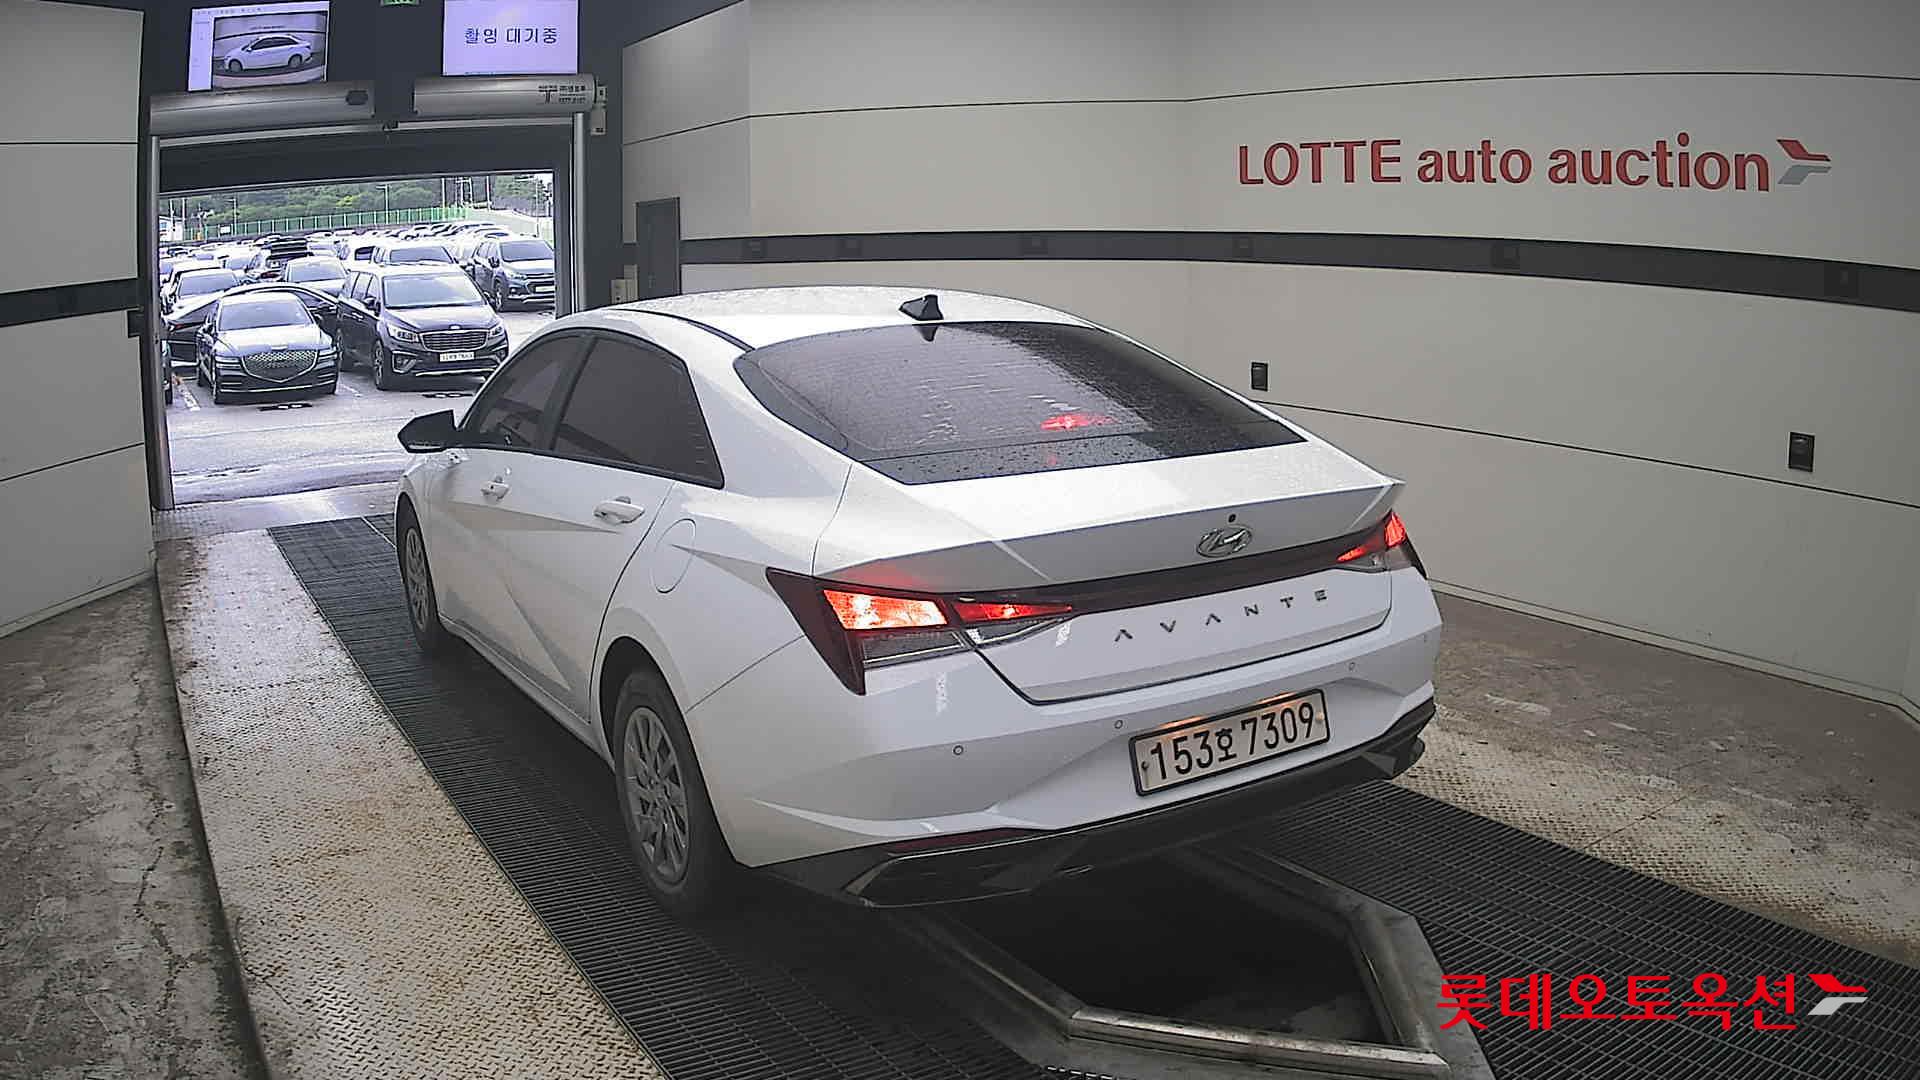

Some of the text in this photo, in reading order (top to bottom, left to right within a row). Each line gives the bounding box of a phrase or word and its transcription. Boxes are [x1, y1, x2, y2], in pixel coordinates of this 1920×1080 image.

[464, 27, 558, 45] 촬영 대기중
[1238, 131, 1771, 192] LOTTE auto auction
[1114, 588, 1329, 642] AVANTE
[1240, 701, 1315, 756] 7309
